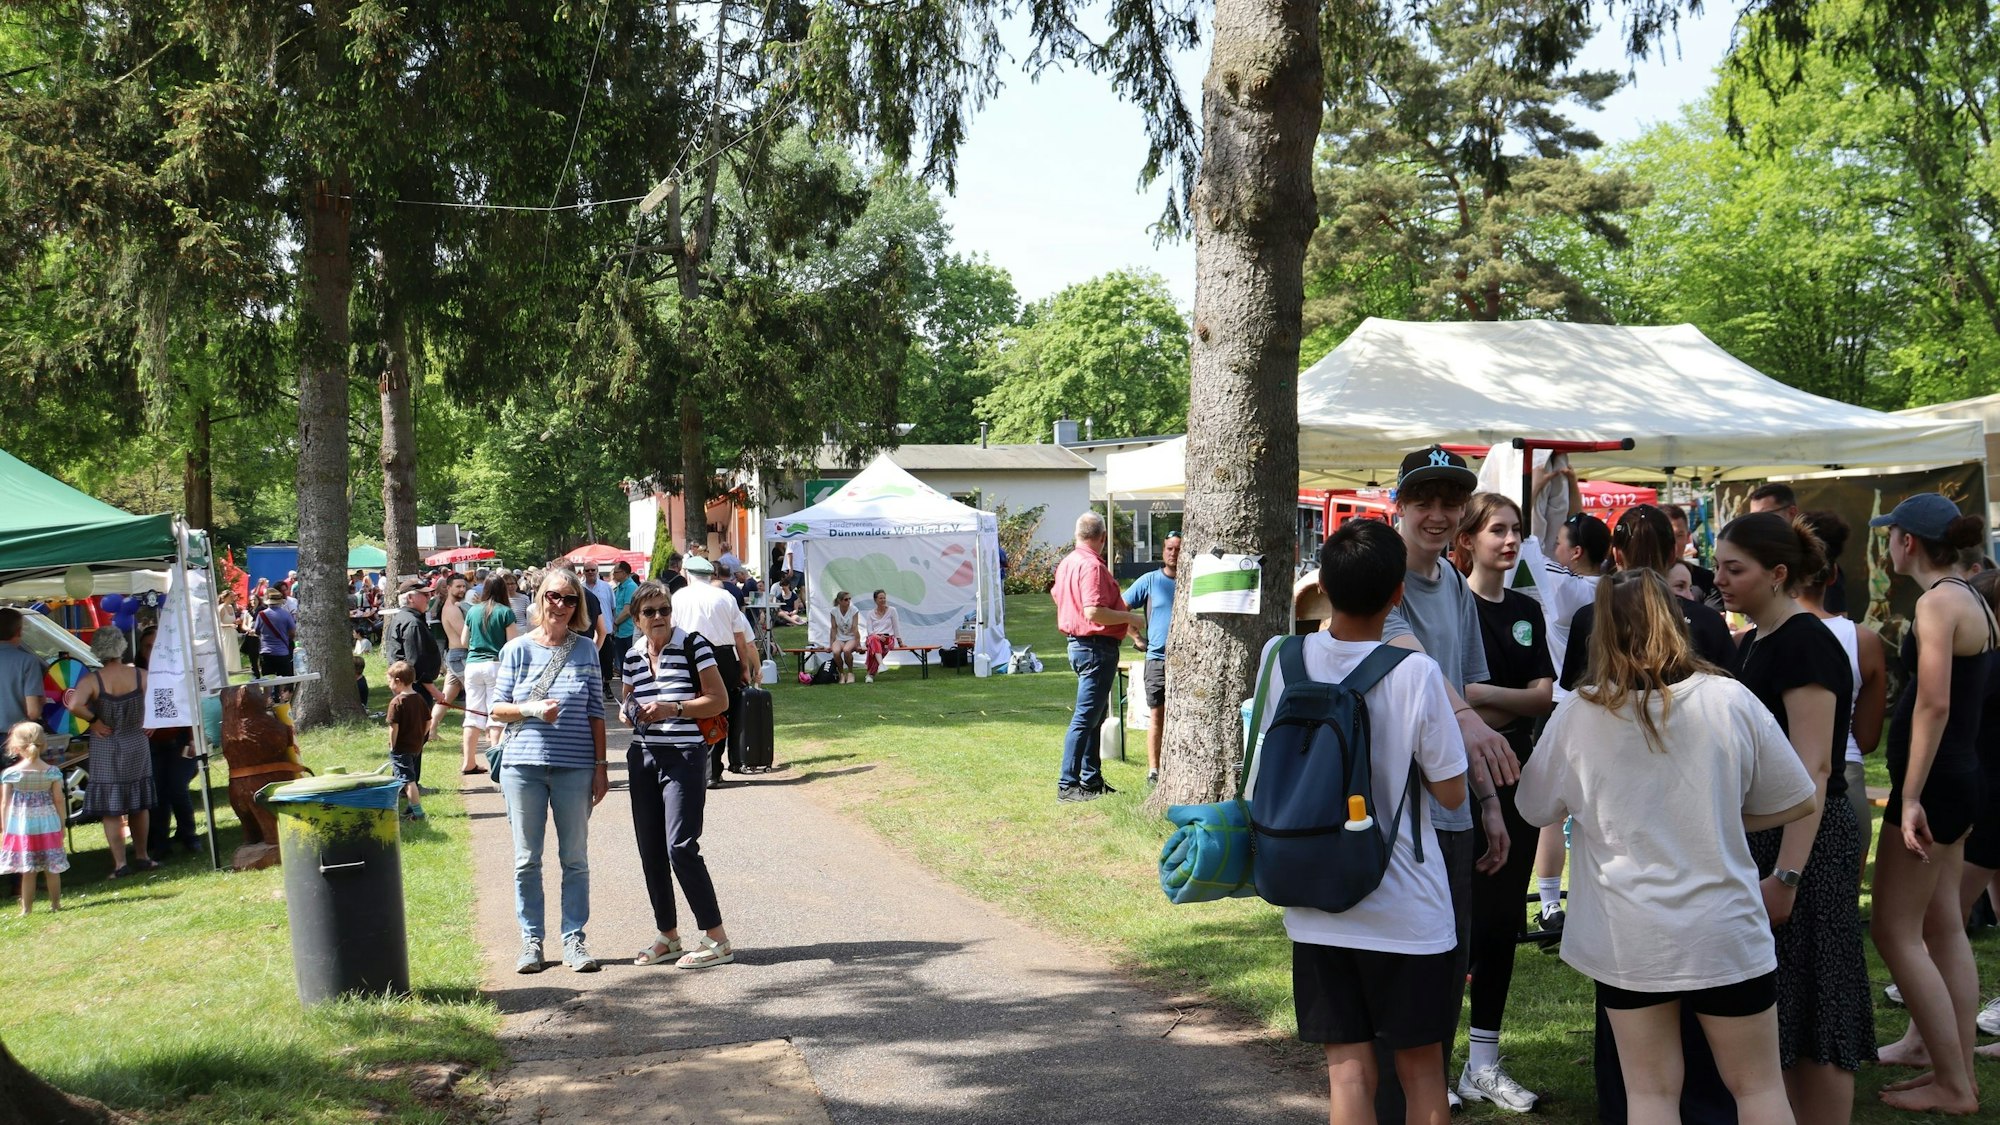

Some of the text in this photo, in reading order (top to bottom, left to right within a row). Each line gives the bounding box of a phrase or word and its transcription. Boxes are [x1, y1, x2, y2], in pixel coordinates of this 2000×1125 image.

[1581, 493, 1637, 507] hr 112
[829, 527, 891, 537] Dünnwalder
[893, 524, 940, 535] Waldbad
